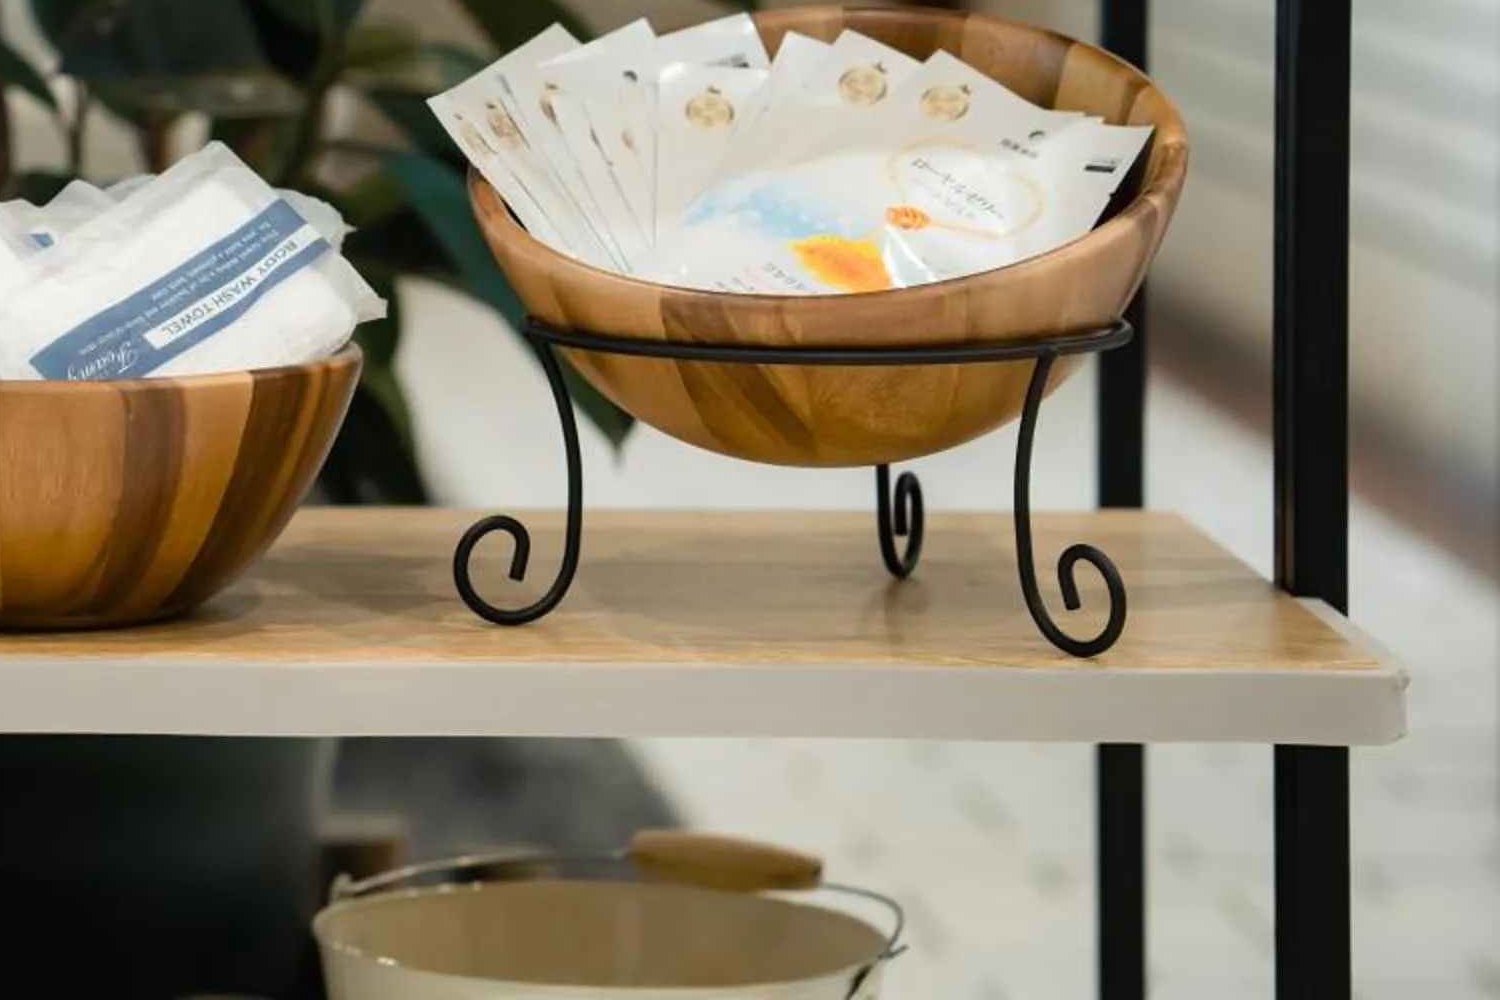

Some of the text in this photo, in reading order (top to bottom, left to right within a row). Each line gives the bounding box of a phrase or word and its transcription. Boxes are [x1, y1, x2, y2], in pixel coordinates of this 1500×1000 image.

[257, 239, 297, 275] BODY
[211, 274, 256, 308] WASH
[161, 301, 214, 336] TOWEL
